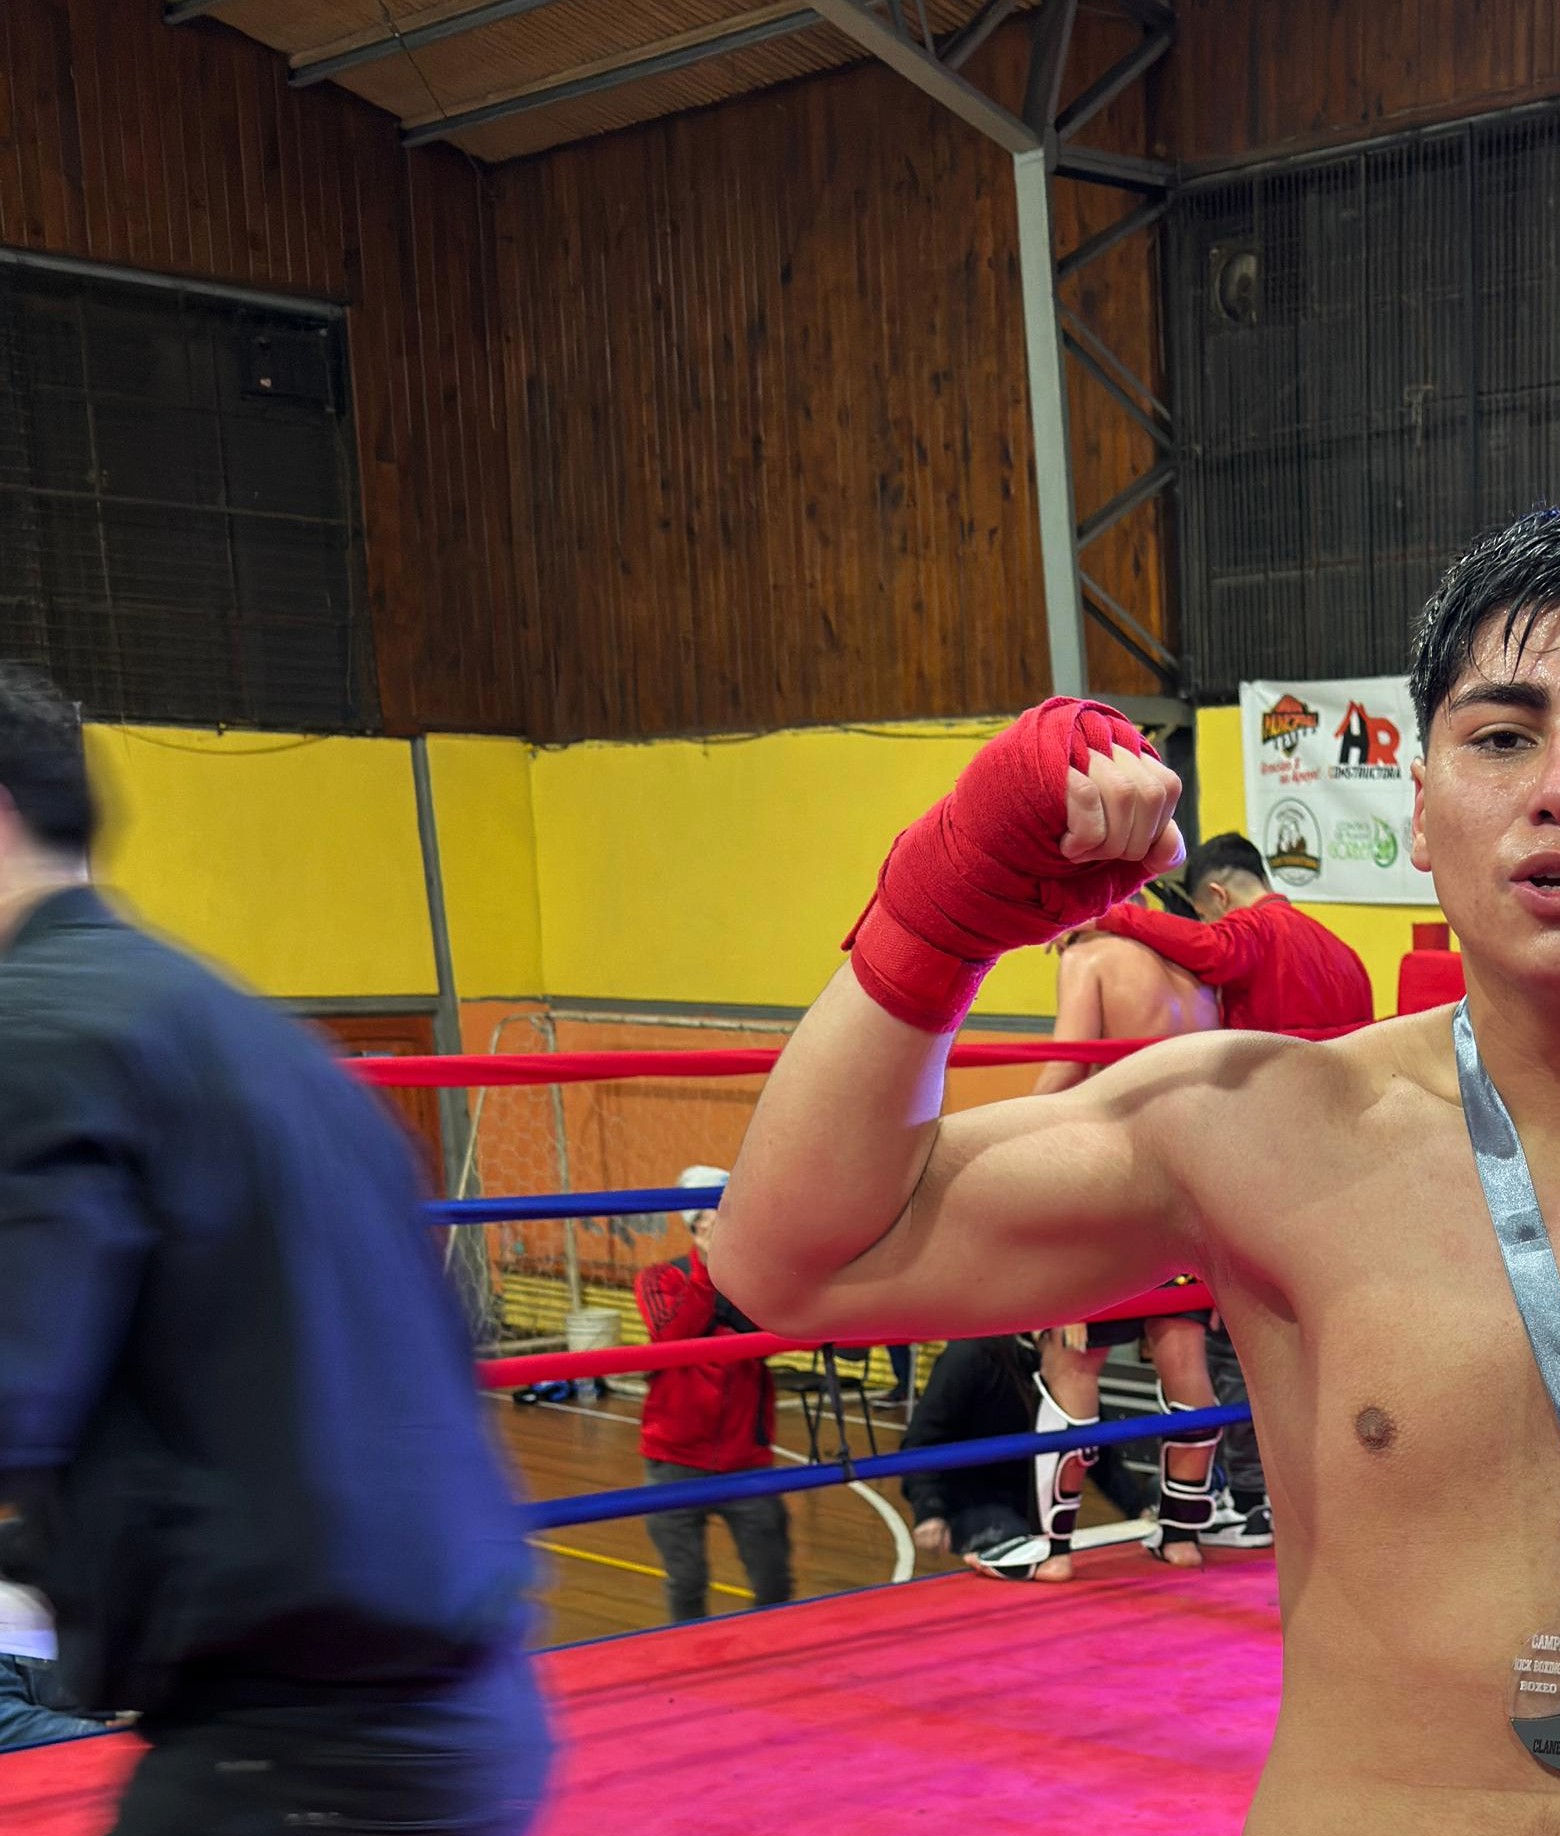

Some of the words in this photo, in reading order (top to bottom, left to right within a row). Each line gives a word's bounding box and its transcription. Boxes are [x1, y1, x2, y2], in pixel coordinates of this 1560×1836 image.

[1334, 700, 1401, 765] AR
[1514, 1658, 1532, 1672] KICK
[1519, 1680, 1558, 1694] BOXEO
